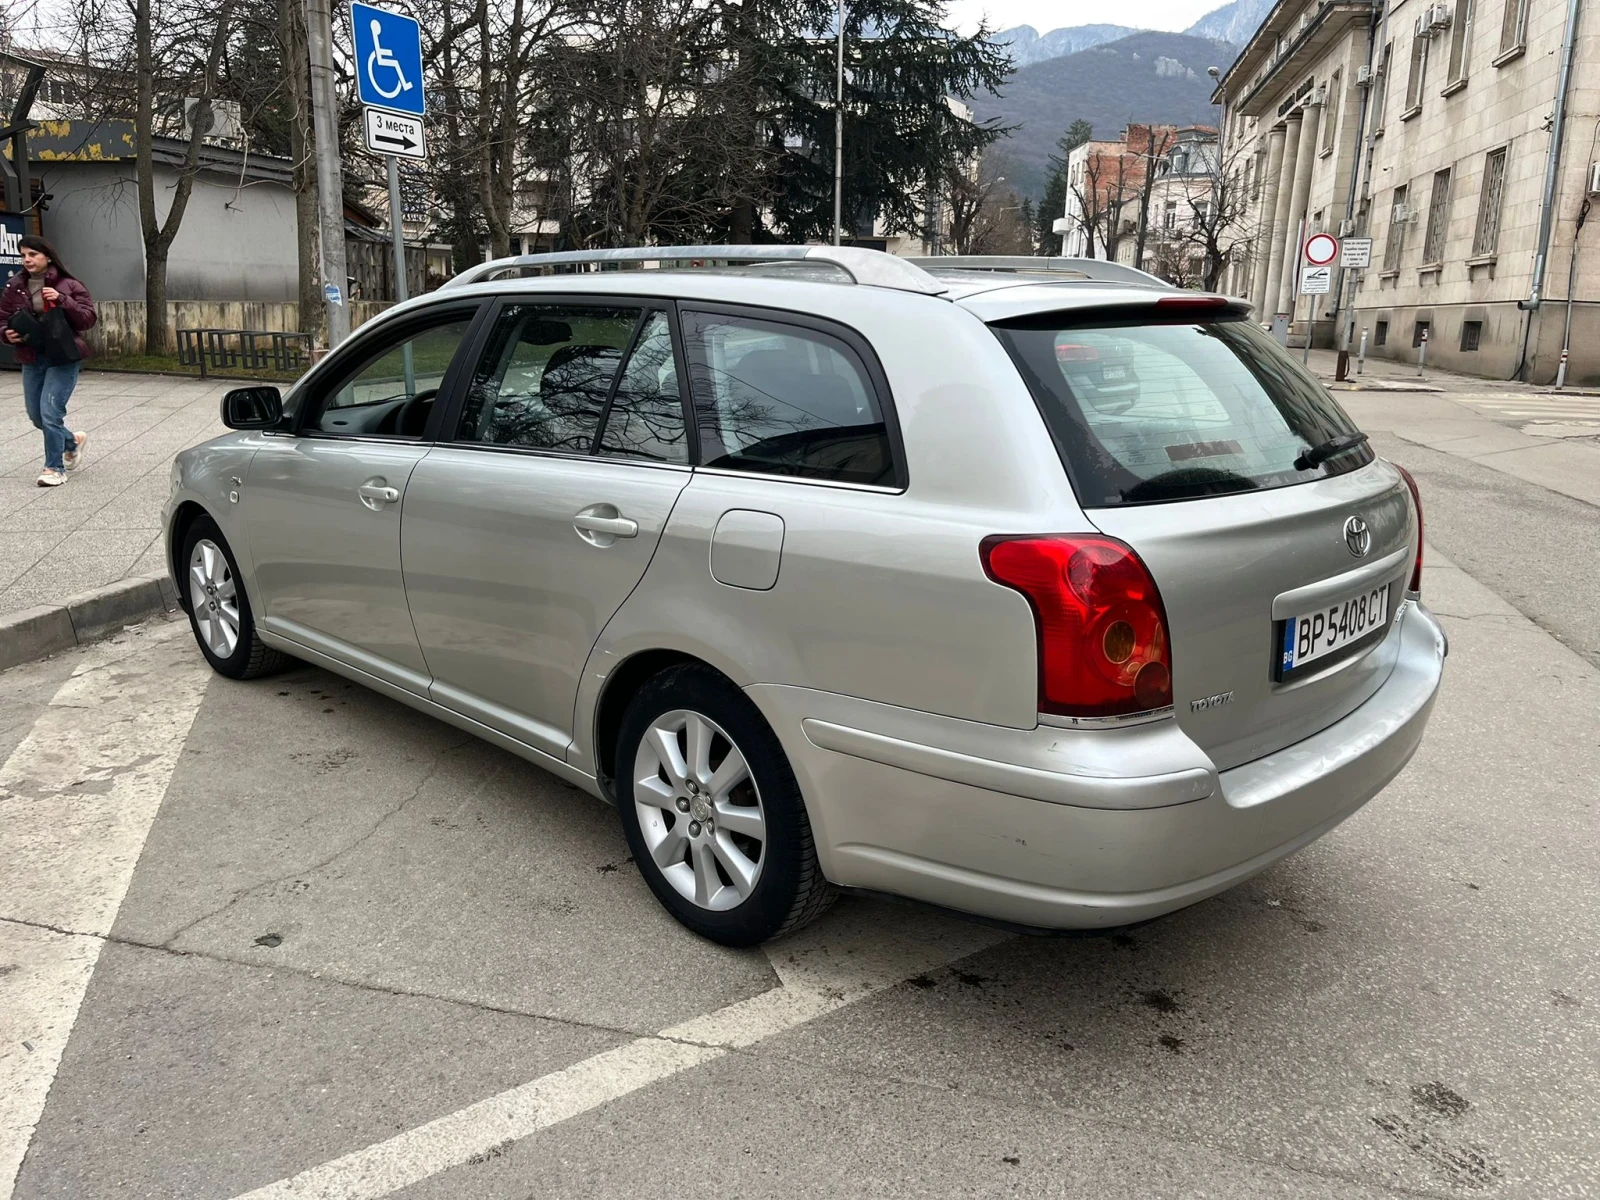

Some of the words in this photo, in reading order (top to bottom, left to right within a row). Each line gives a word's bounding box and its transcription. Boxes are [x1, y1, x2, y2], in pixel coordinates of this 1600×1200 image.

[376, 115, 383, 129] 3
[385, 120, 415, 135] места
[1283, 650, 1293, 665] BG
[1189, 689, 1235, 713] TOYOTA
